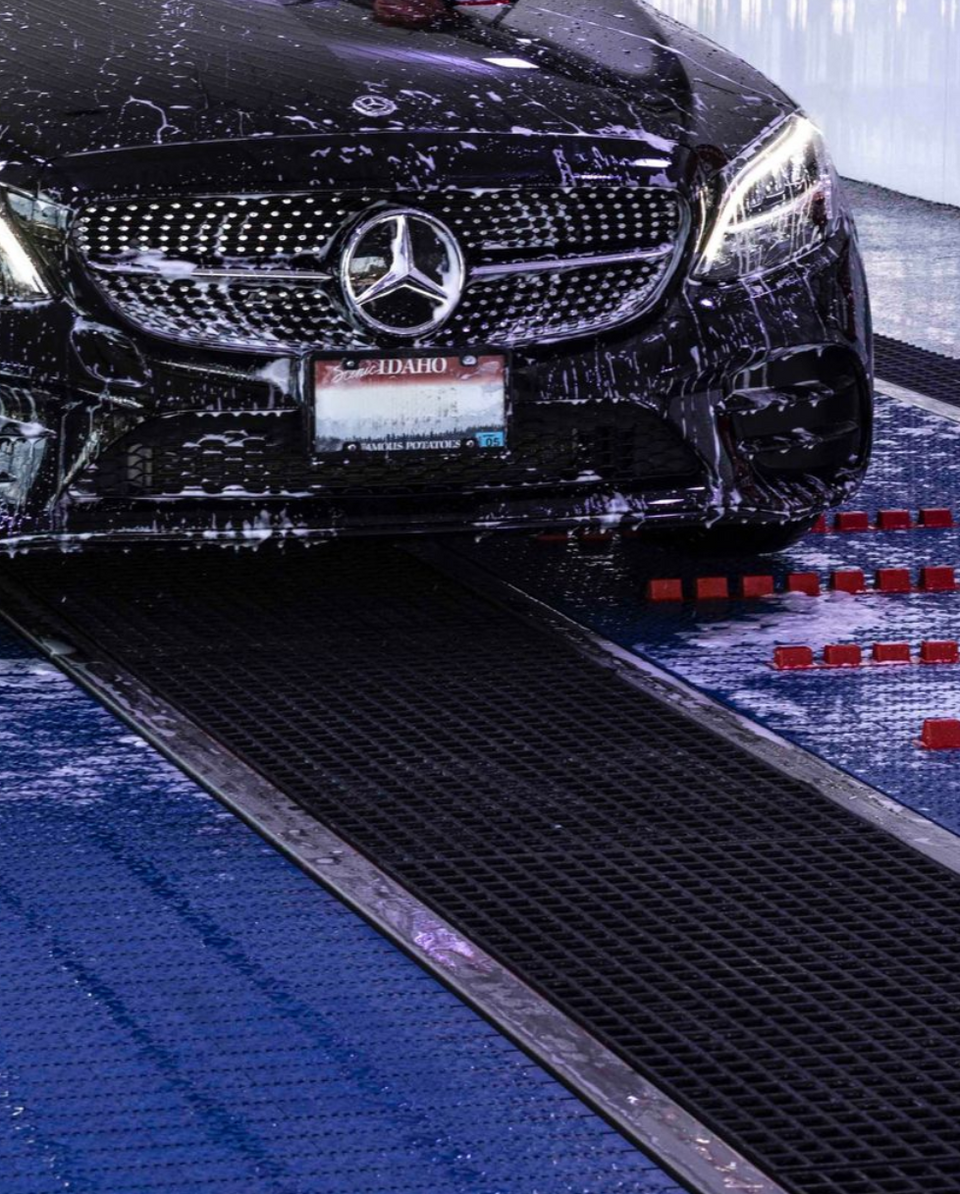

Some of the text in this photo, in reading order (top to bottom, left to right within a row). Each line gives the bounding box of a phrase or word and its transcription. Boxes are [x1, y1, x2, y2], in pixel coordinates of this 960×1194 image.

[378, 357, 447, 375] IDAHO
[360, 439, 461, 452] FAMOUS POTATOES
